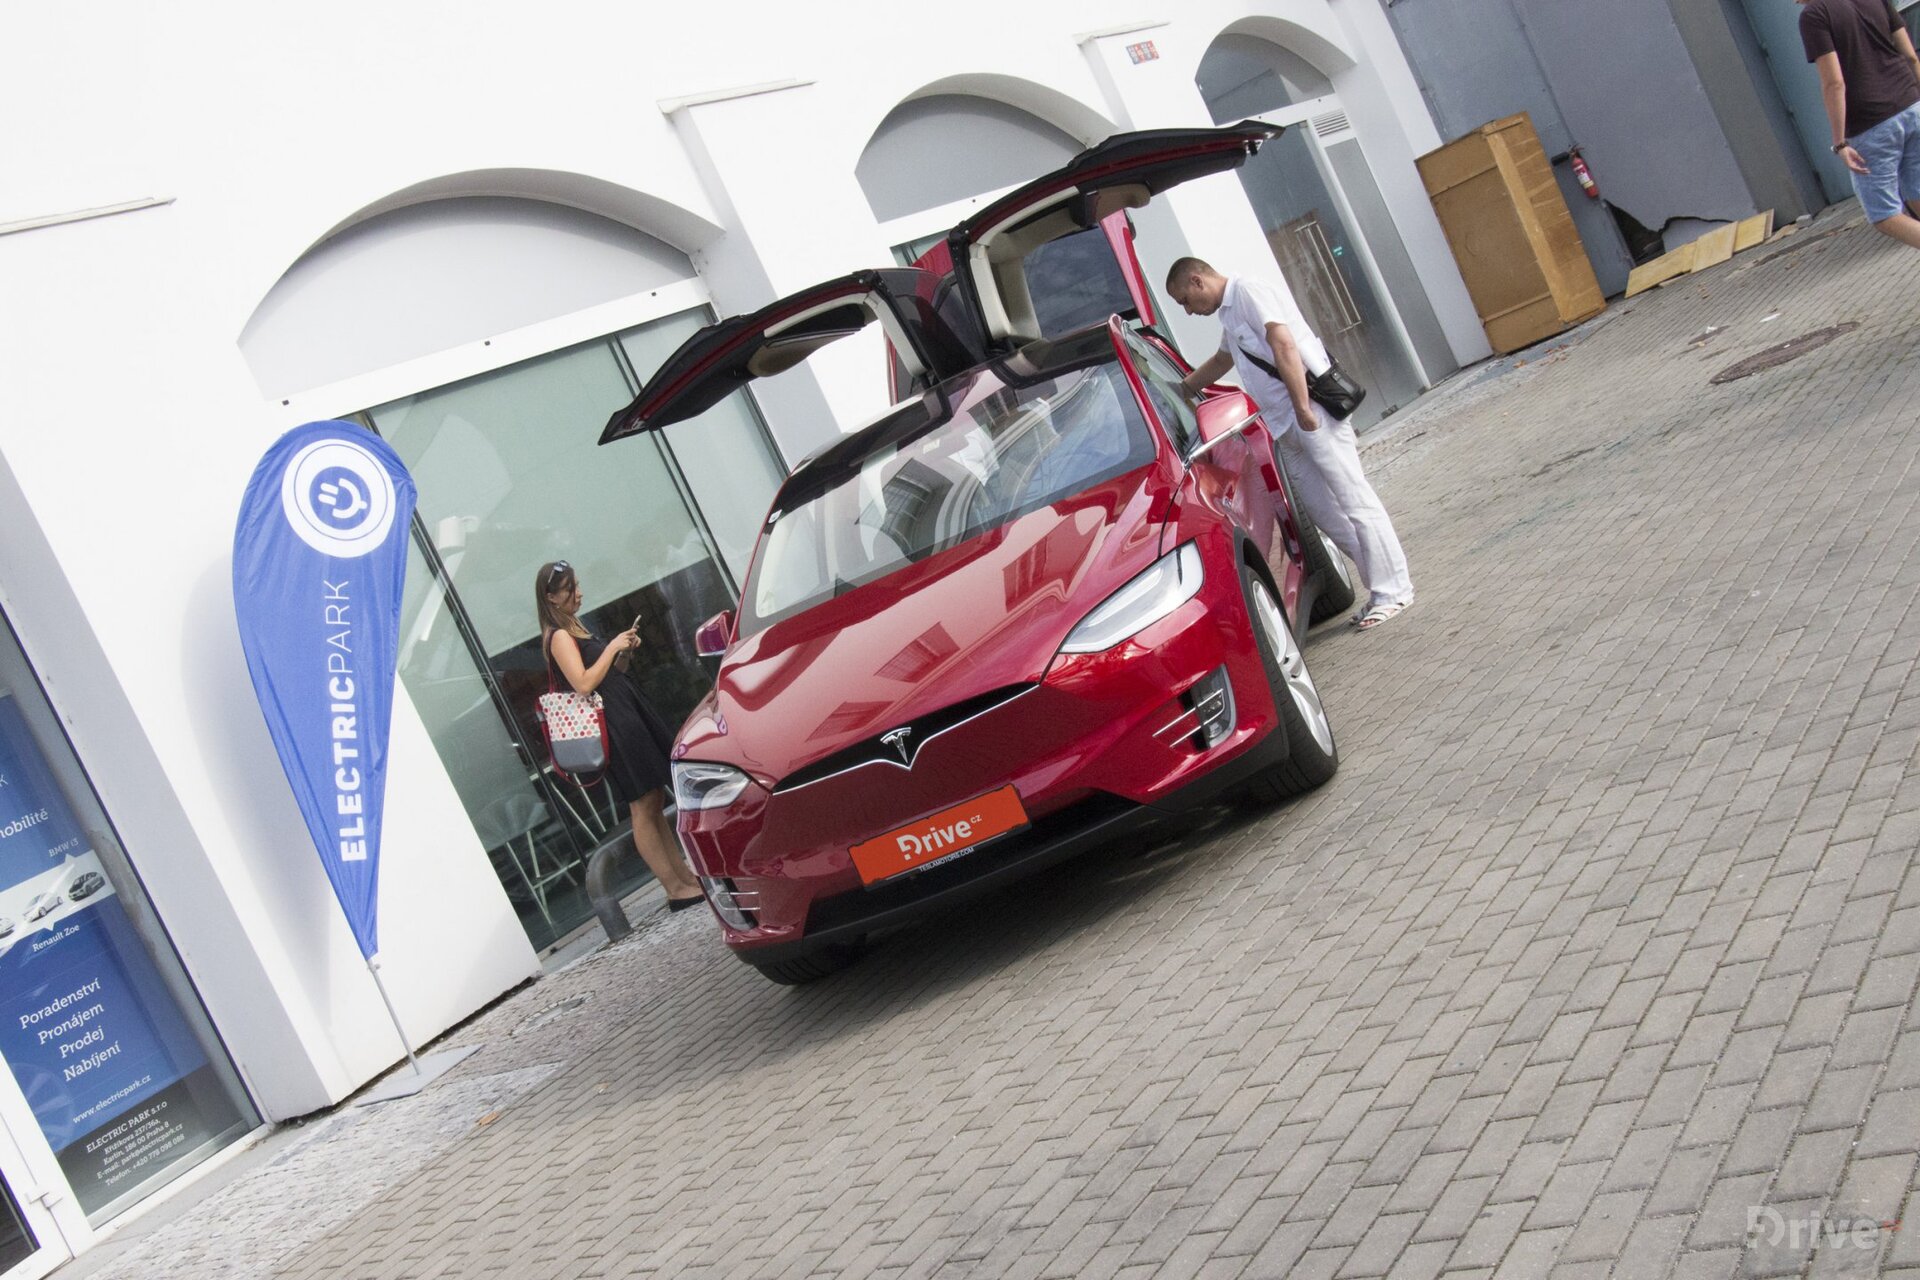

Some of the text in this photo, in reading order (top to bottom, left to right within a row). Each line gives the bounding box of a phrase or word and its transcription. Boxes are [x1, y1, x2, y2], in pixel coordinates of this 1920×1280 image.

[48, 841, 70, 858] BMW
[896, 819, 973, 861] Drive
[32, 923, 81, 953] Renault Zoe
[19, 977, 102, 1030] Poradenství
[37, 1002, 105, 1046] Pronájem
[59, 1025, 105, 1059] Prodej
[63, 1040, 122, 1082] Nabíjení
[72, 1074, 152, 1124] www.electricpark.cz
[86, 1123, 128, 1154] ELECTRIC
[128, 1109, 151, 1128] PARK
